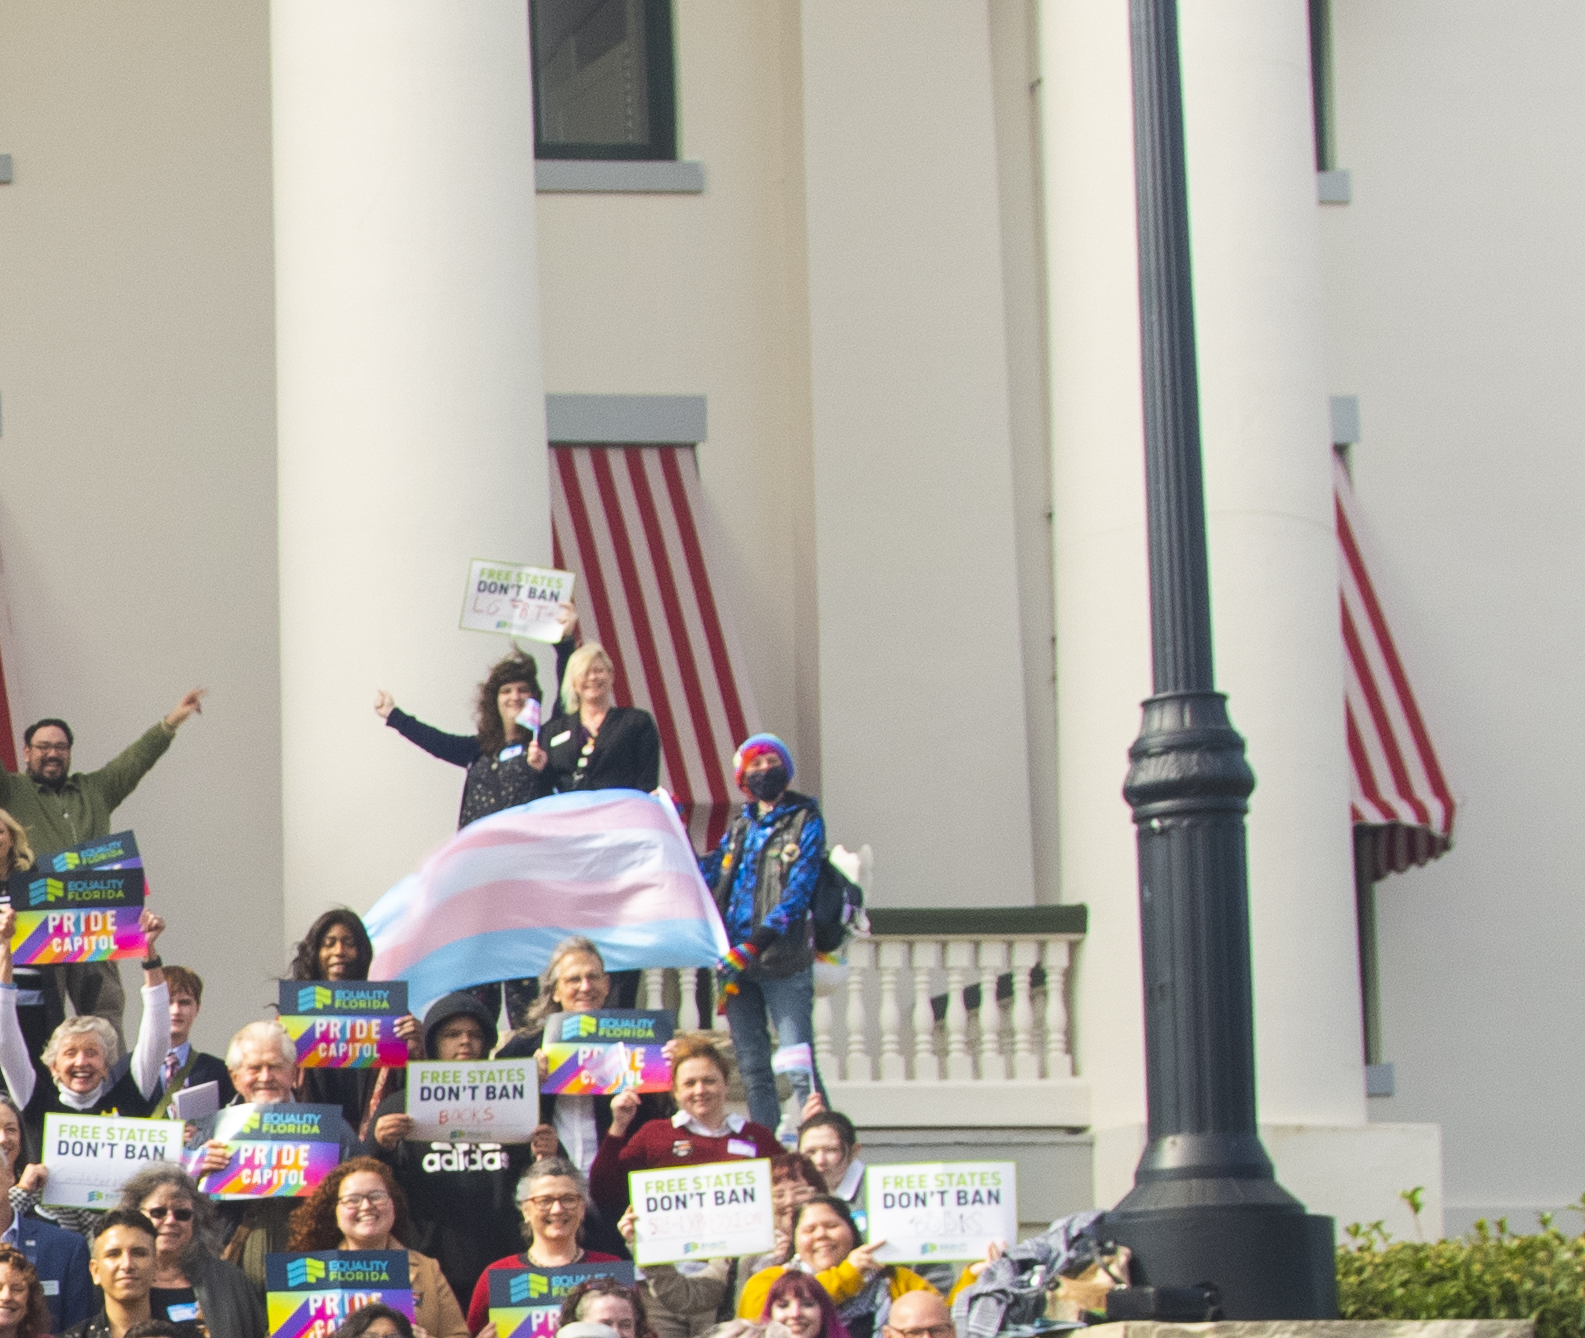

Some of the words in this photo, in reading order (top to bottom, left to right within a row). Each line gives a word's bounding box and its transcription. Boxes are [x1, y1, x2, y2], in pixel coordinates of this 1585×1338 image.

[478, 567, 513, 582] FREE
[515, 572, 563, 589] STATES
[476, 579, 524, 597] DON'T
[527, 586, 559, 602] BAN
[48, 909, 117, 933] PRIDE
[52, 933, 117, 953] CAPITOL
[315, 1019, 381, 1038] PRIDE
[420, 1070, 461, 1083] FREE
[466, 1068, 527, 1083] STATES
[421, 1085, 478, 1101] DON'T
[484, 1084, 525, 1100] BAN
[57, 1123, 101, 1139] FREE
[106, 1126, 168, 1143] STATES
[56, 1139, 118, 1158] DON'T
[124, 1143, 165, 1161] BAN
[239, 1144, 310, 1164] PRIDE
[241, 1168, 309, 1185] CAPITOL
[643, 1177, 688, 1194] FREE
[692, 1170, 755, 1190] STATES
[881, 1174, 928, 1190] FREE
[934, 1171, 1001, 1188] STATES
[645, 1191, 707, 1213] DON'T
[713, 1186, 755, 1206] BAN
[882, 1190, 948, 1209] DON'T
[956, 1188, 1000, 1206] BAN
